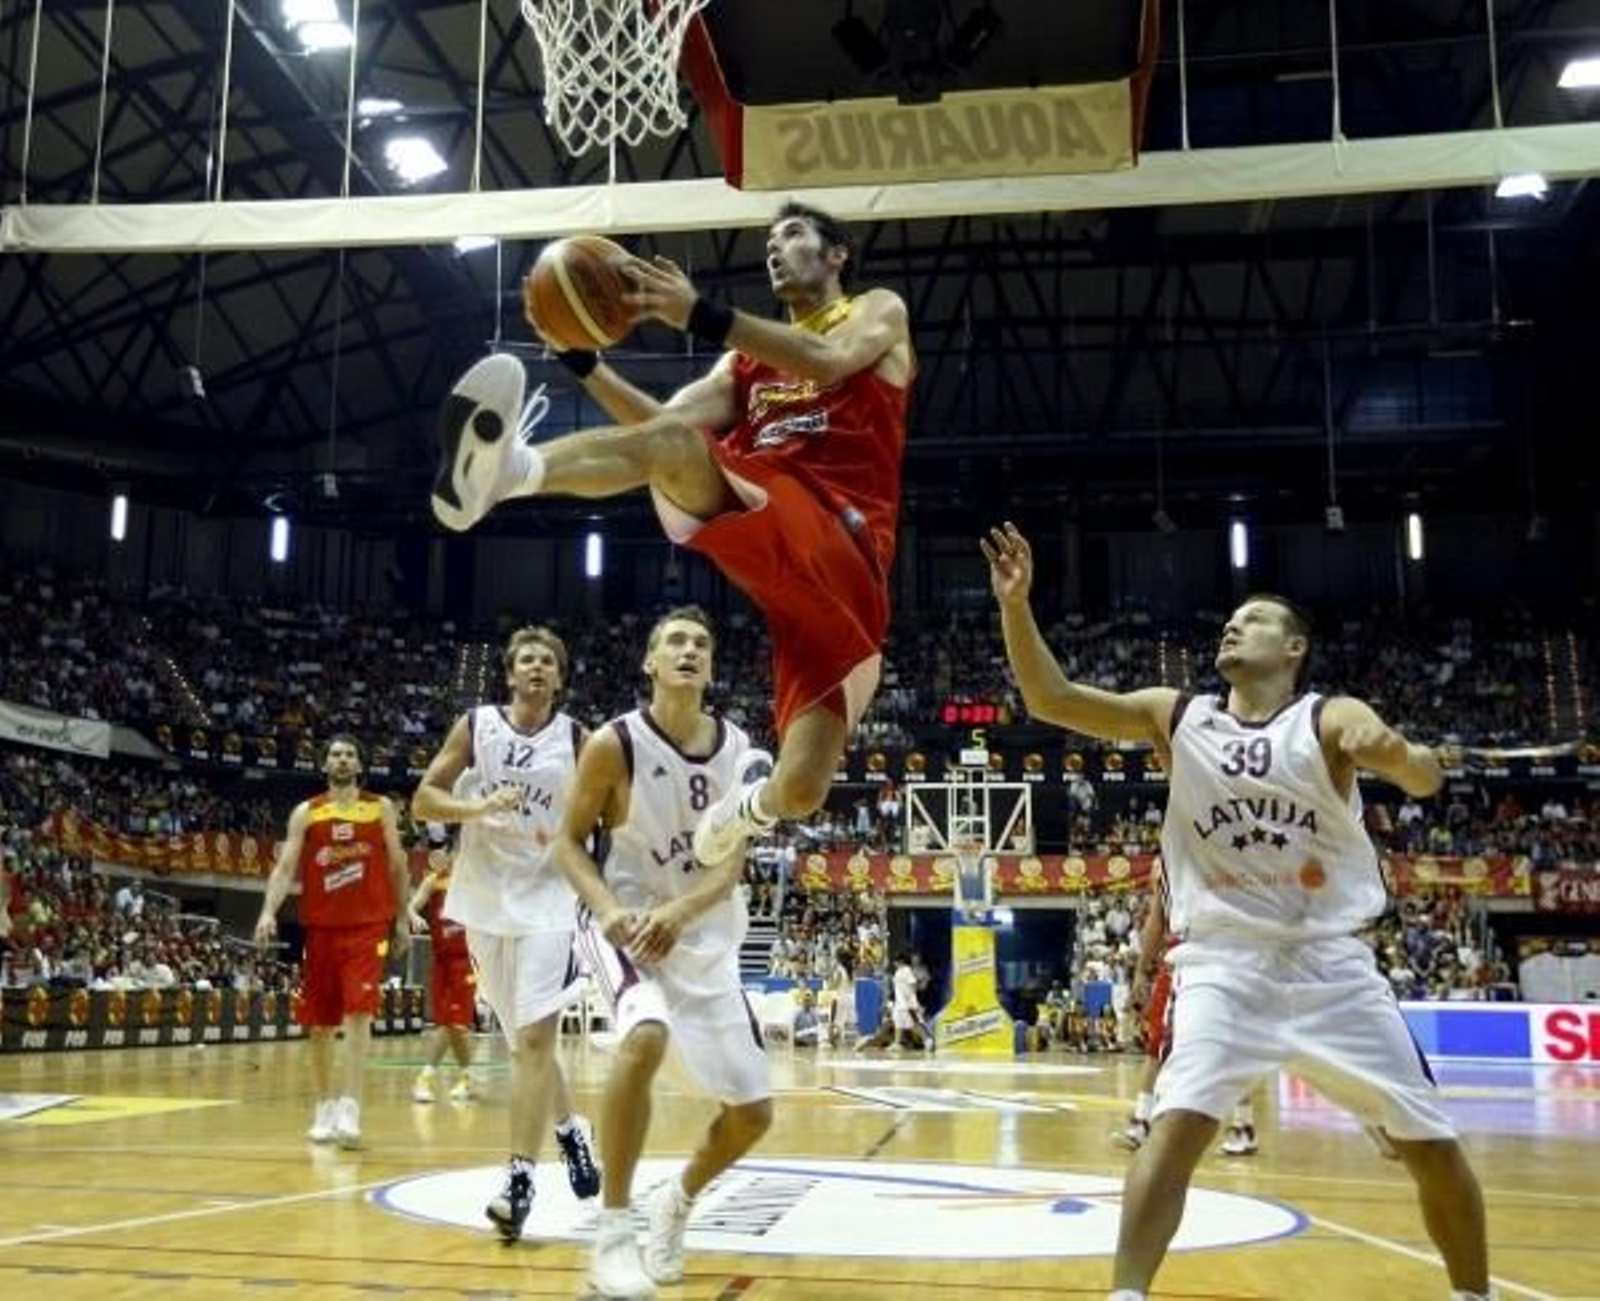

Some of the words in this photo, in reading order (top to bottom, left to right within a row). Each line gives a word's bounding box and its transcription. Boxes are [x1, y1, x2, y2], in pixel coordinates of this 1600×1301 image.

[503, 741, 534, 768] 12
[1221, 737, 1272, 778] 39
[689, 774, 709, 811] 8
[1193, 797, 1318, 841] LATVIJA
